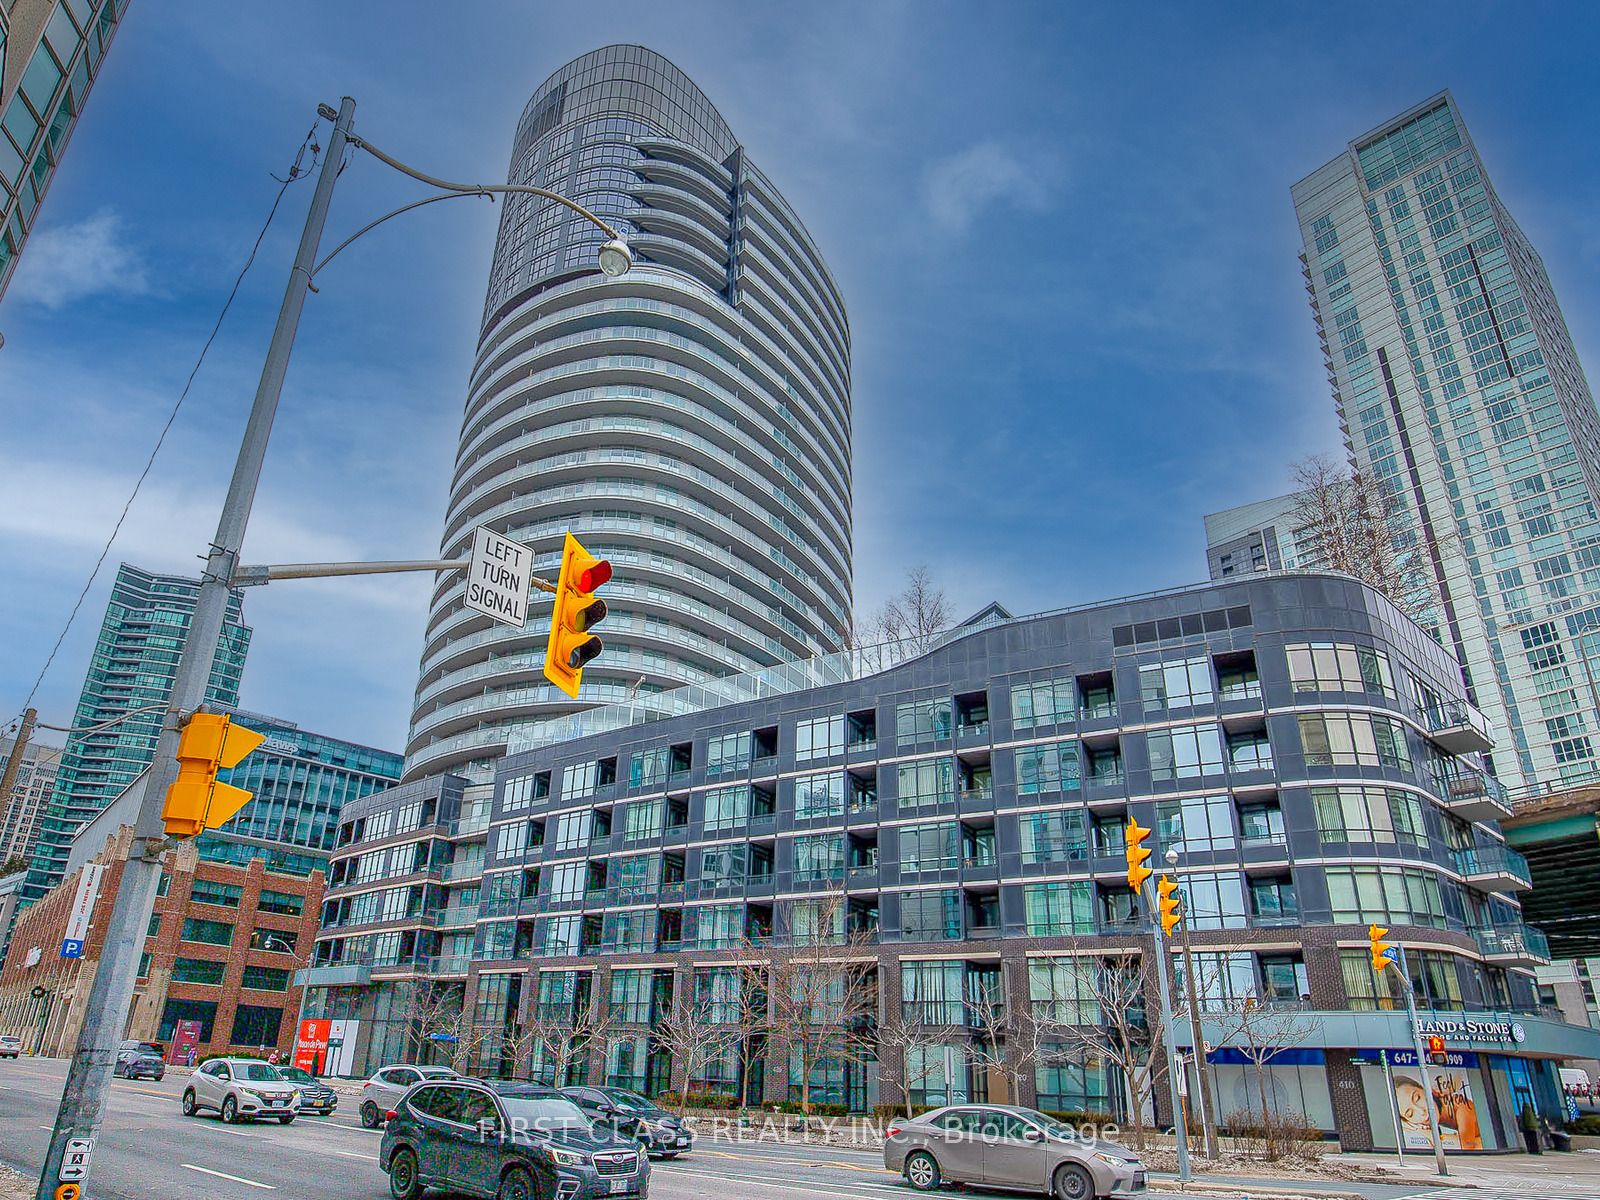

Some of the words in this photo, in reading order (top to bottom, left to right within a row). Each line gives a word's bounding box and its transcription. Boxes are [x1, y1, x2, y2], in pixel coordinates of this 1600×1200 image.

[485, 537, 522, 567] LEFT
[482, 560, 520, 593] TURN
[469, 583, 522, 620] SIGNAL
[66, 942, 78, 954] P
[1410, 1019, 1457, 1033] HAND
[1458, 1023, 1466, 1031] &
[1466, 1020, 1509, 1034] STONE
[1434, 1072, 1456, 1094] Feel
[1443, 1080, 1473, 1120] great
